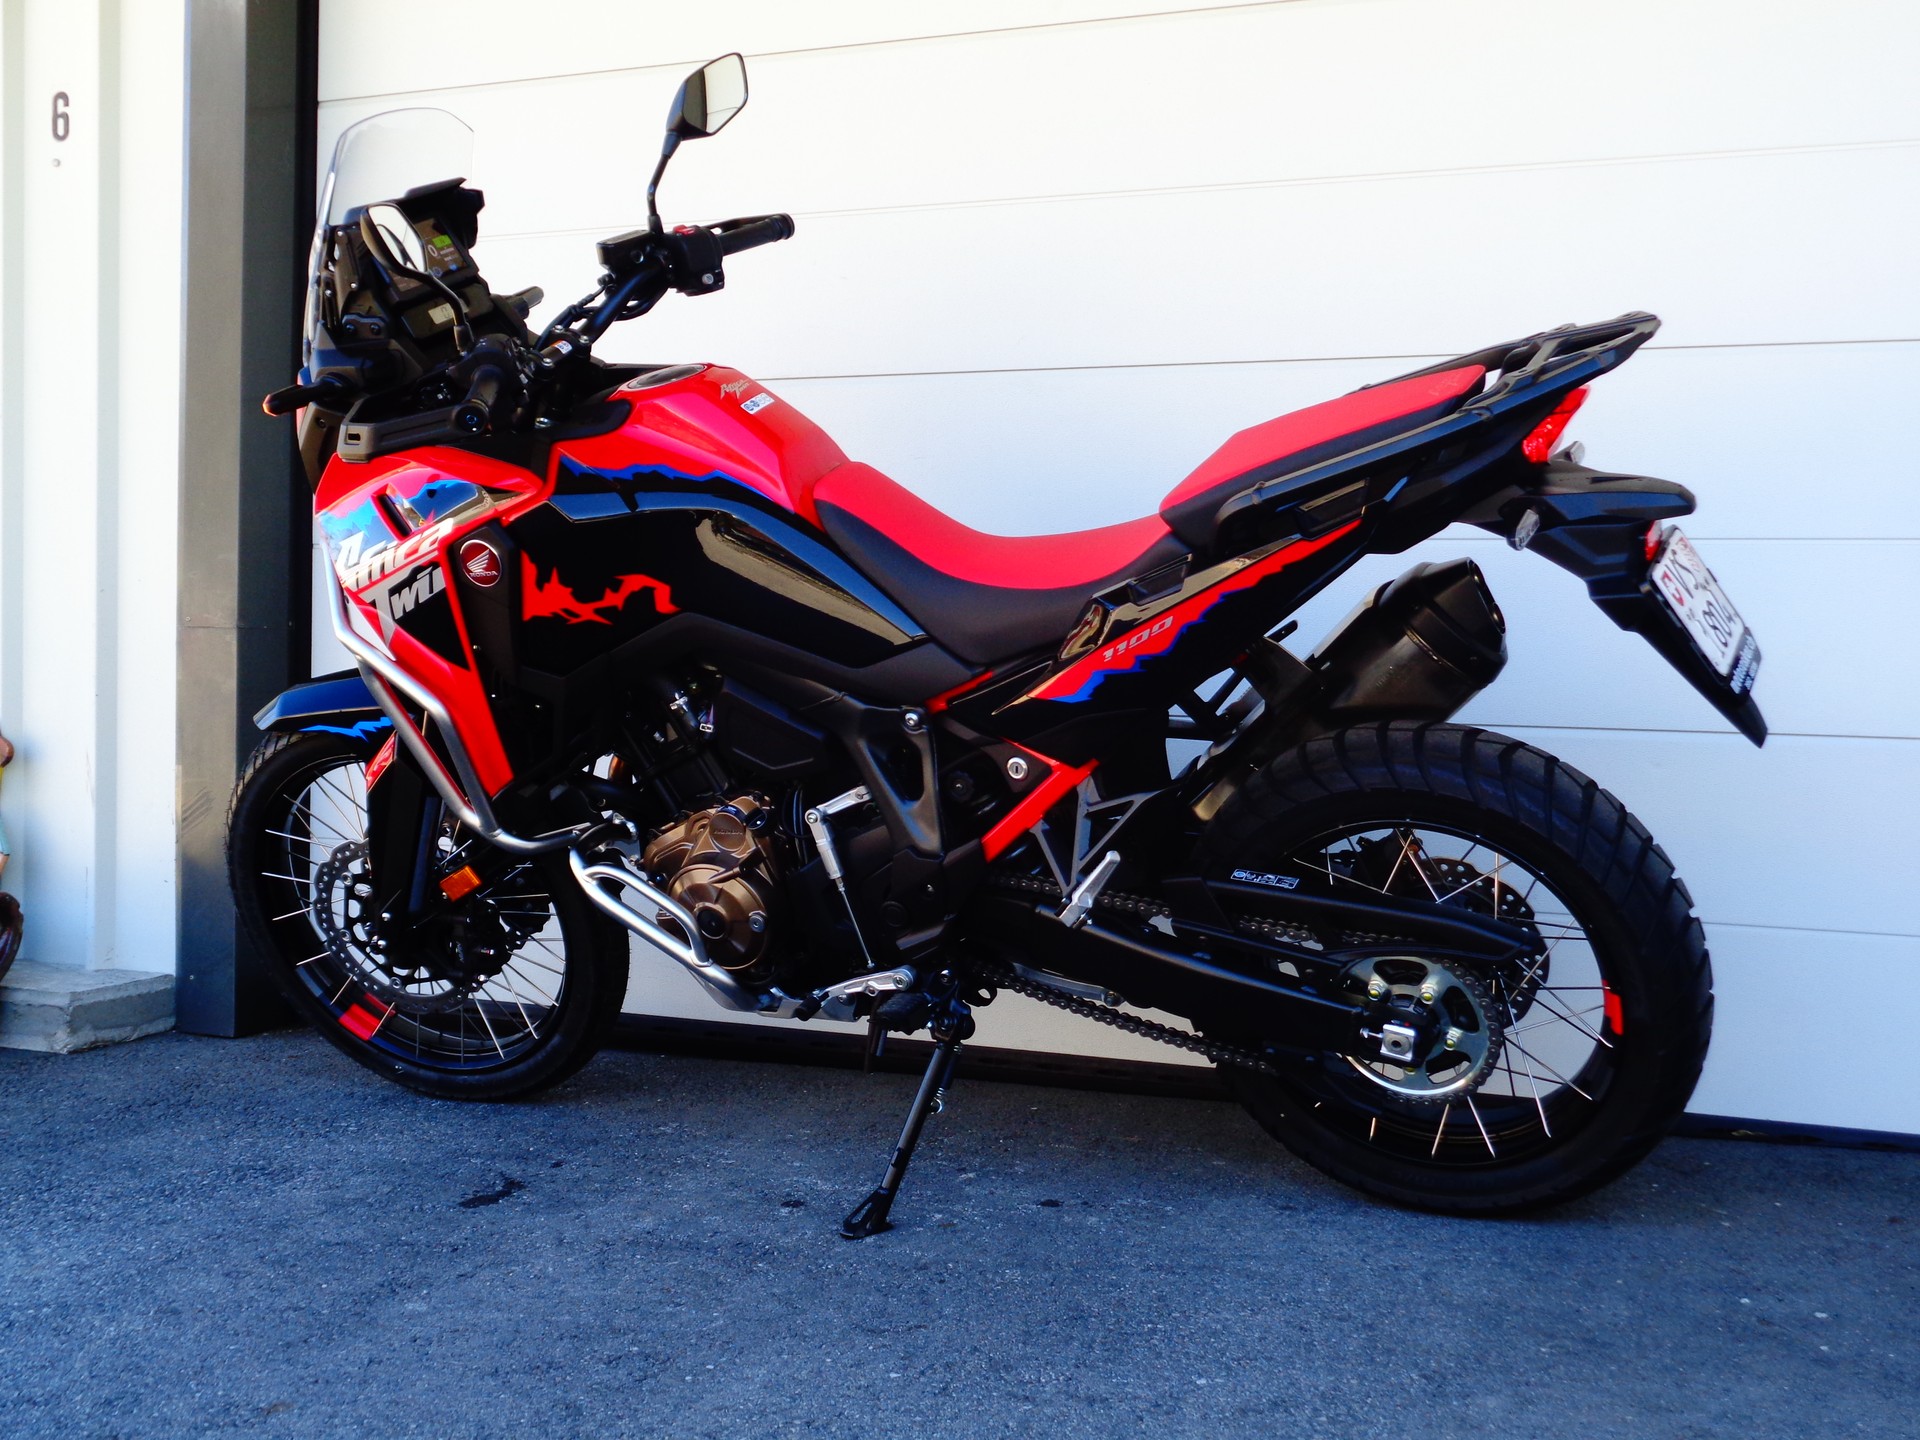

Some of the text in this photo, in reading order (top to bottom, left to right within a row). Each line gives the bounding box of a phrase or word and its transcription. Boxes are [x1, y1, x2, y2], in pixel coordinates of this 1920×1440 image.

[51, 90, 70, 142] 6
[469, 570, 499, 578] HONDA
[1102, 615, 1174, 663] 1100
